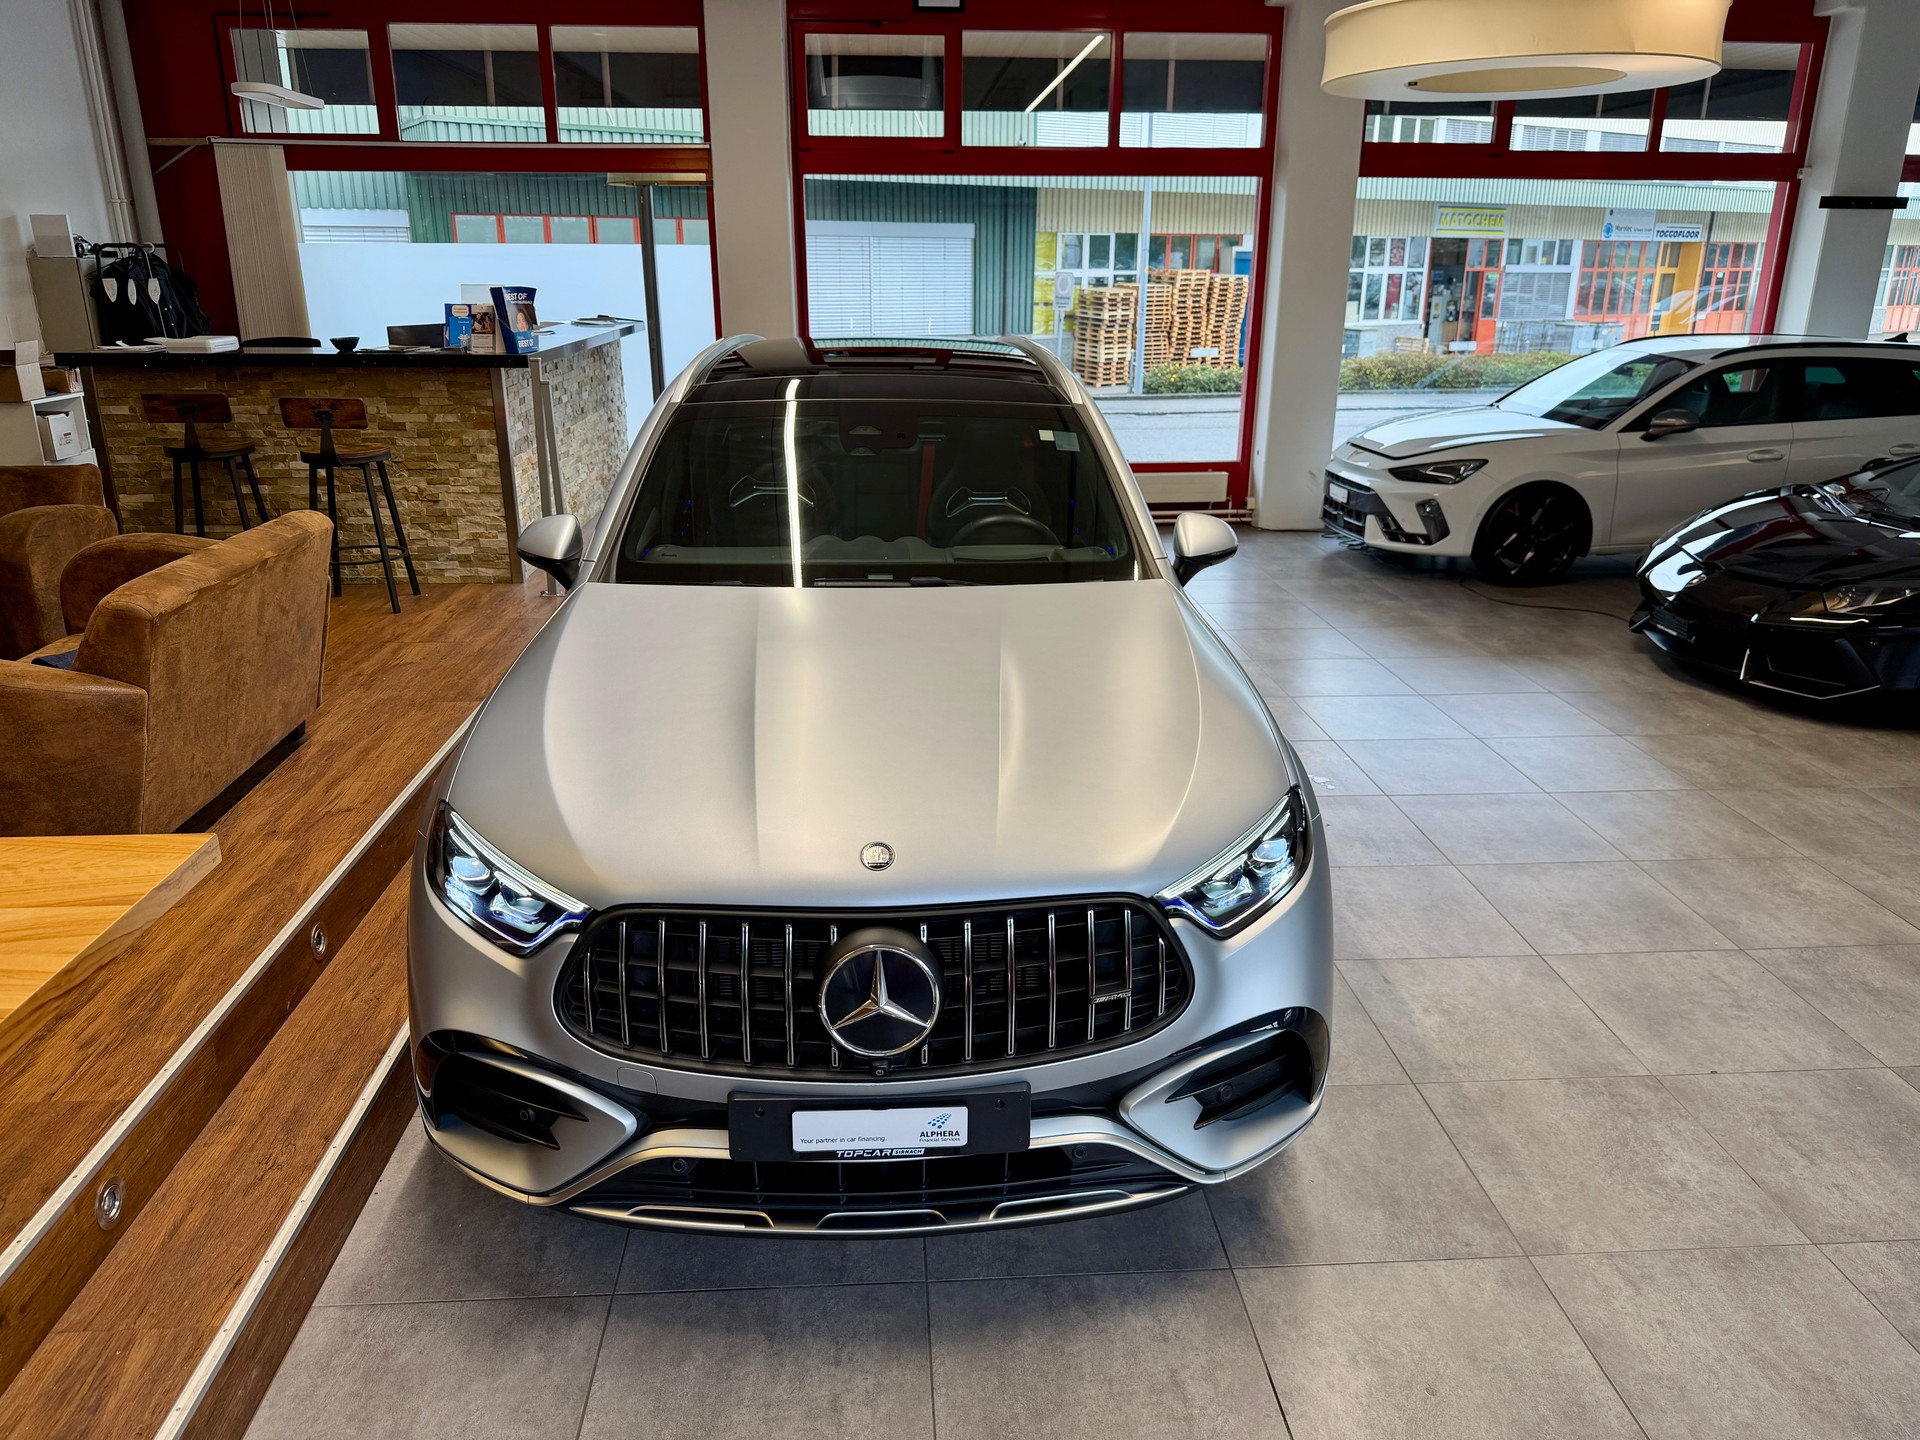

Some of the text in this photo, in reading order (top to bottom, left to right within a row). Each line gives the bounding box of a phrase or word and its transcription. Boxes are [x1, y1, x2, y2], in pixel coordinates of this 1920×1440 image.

[1439, 212, 1505, 228] MATOCHEM
[505, 292, 528, 301] BEST OF
[858, 1135, 887, 1143] financing.
[836, 1149, 891, 1158] TOPCAR
